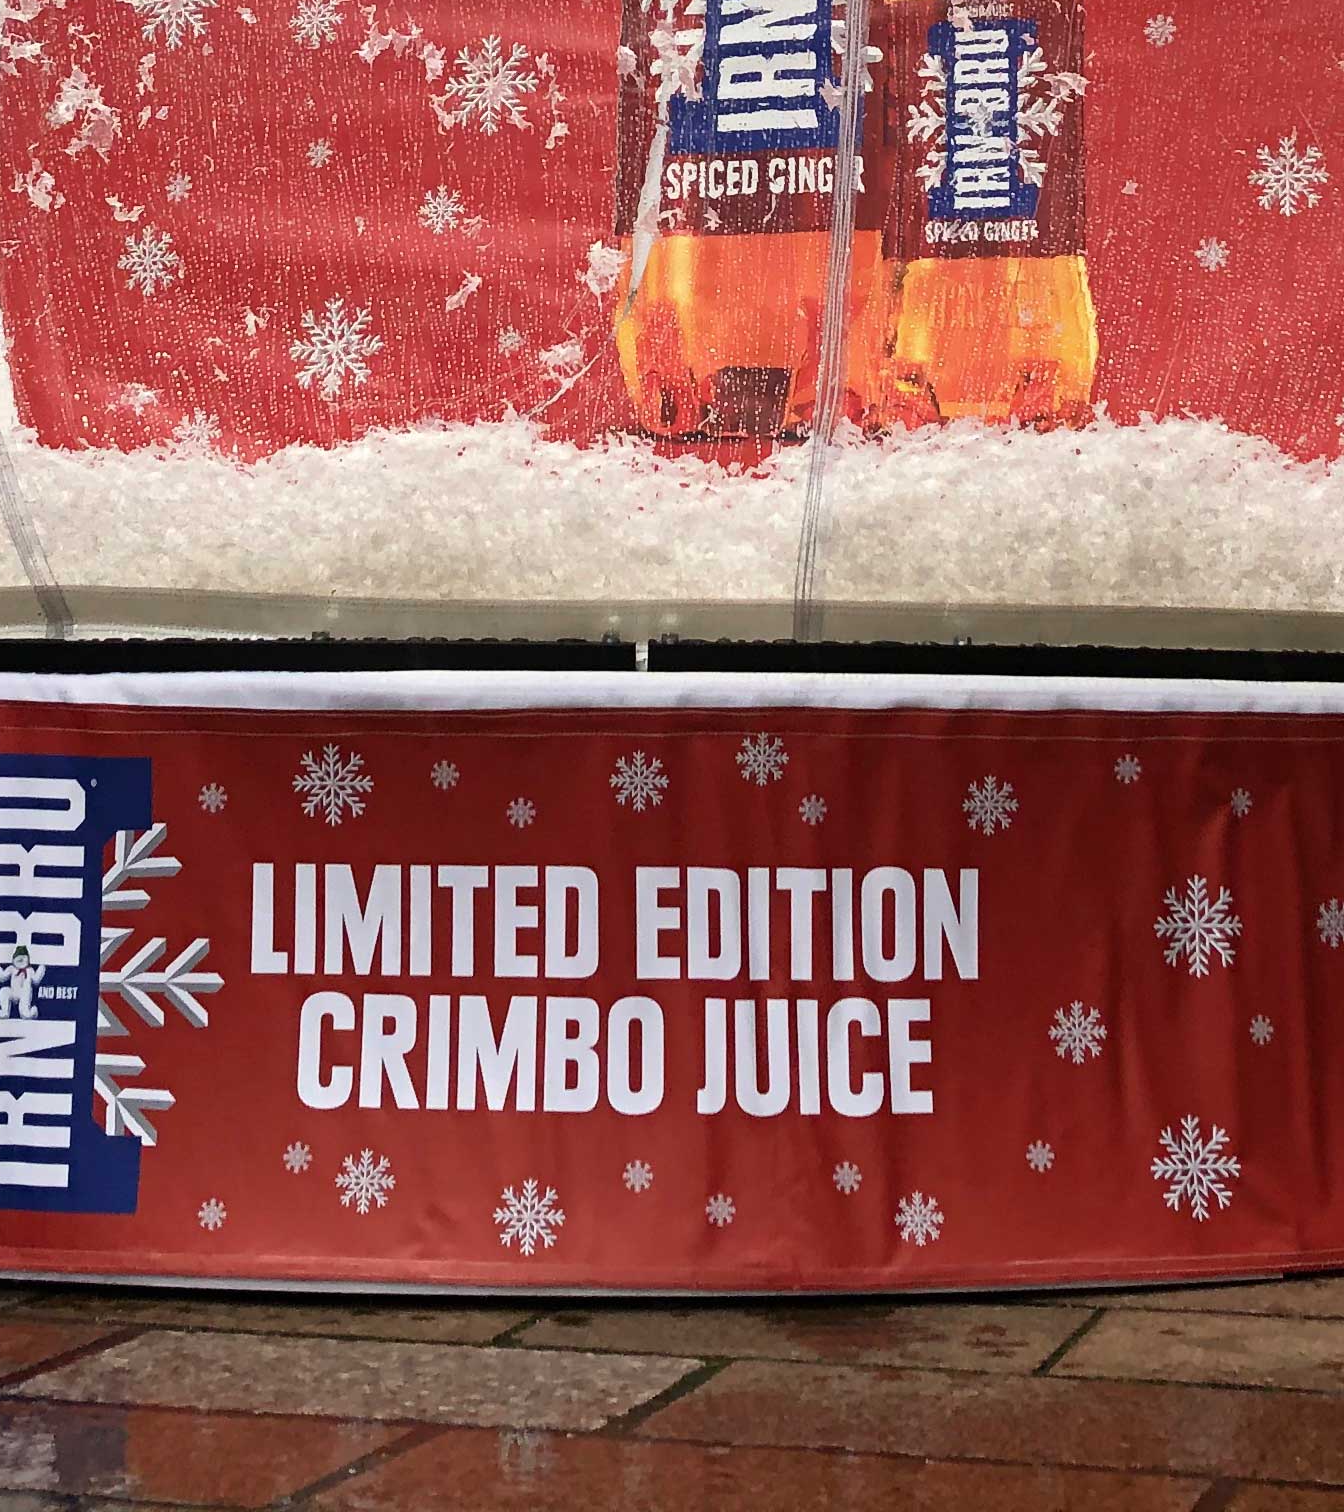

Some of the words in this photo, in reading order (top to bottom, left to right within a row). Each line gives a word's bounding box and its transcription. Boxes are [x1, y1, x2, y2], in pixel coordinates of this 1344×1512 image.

[666, 159, 759, 200] SPICED
[768, 155, 866, 195] GINGR
[925, 220, 978, 243] SPID
[984, 220, 1039, 242] GINGER
[251, 862, 601, 980] LIMITED
[636, 866, 980, 981] EDITION
[56, 986, 78, 1000] BEST
[296, 991, 665, 1117] CRIMBO
[697, 997, 934, 1117] JUICE
